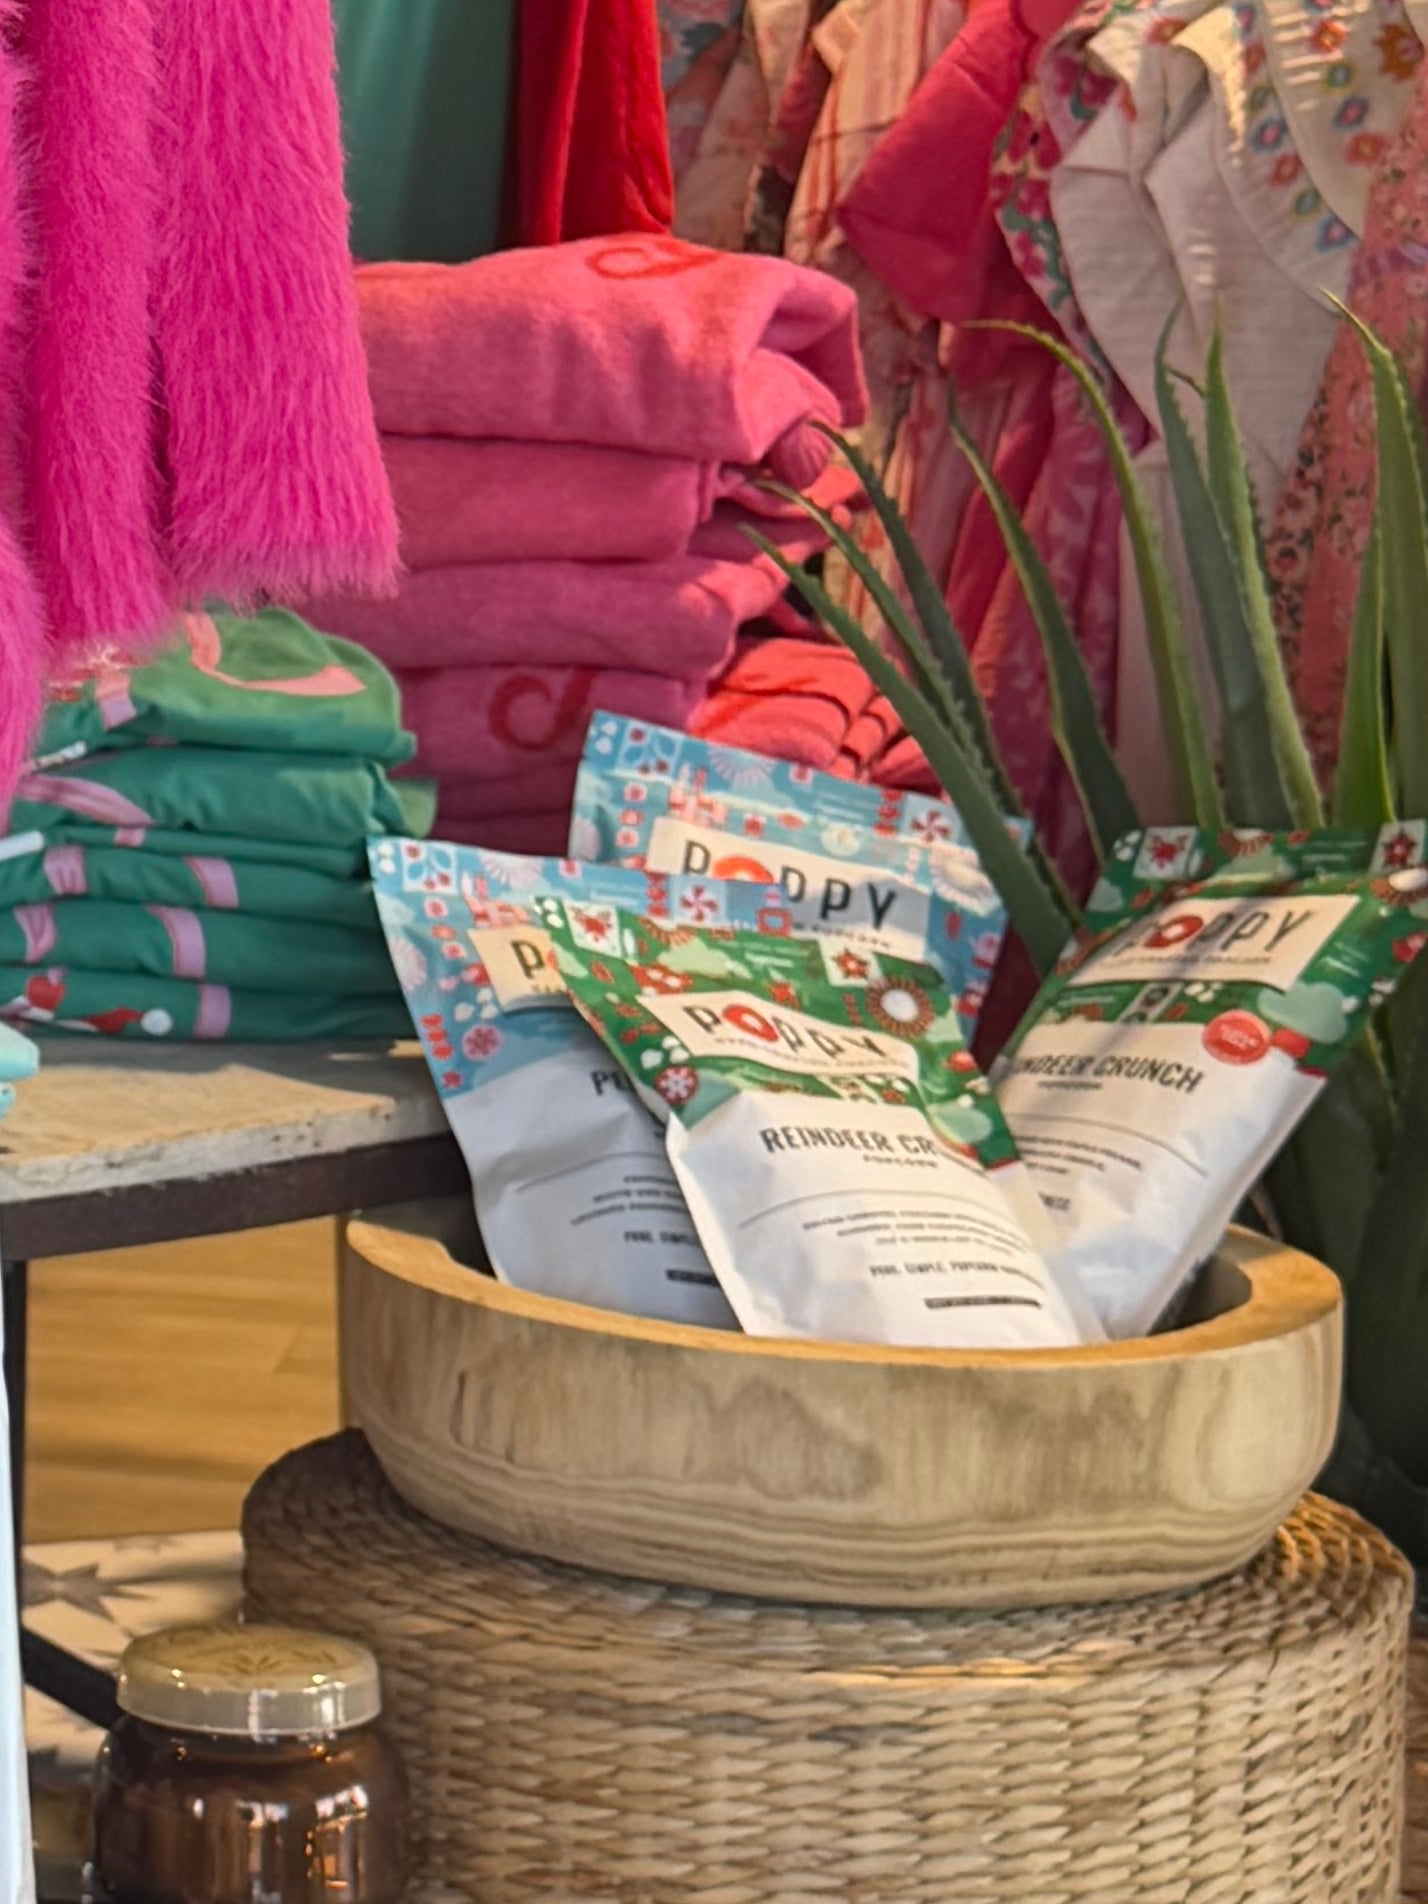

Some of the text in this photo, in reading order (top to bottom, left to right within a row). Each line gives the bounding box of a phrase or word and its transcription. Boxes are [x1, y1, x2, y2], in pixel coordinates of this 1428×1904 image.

[683, 1003, 888, 1059] POPPY
[1093, 1054, 1205, 1094] CRUNCH
[759, 1127, 894, 1154] REINDEER
